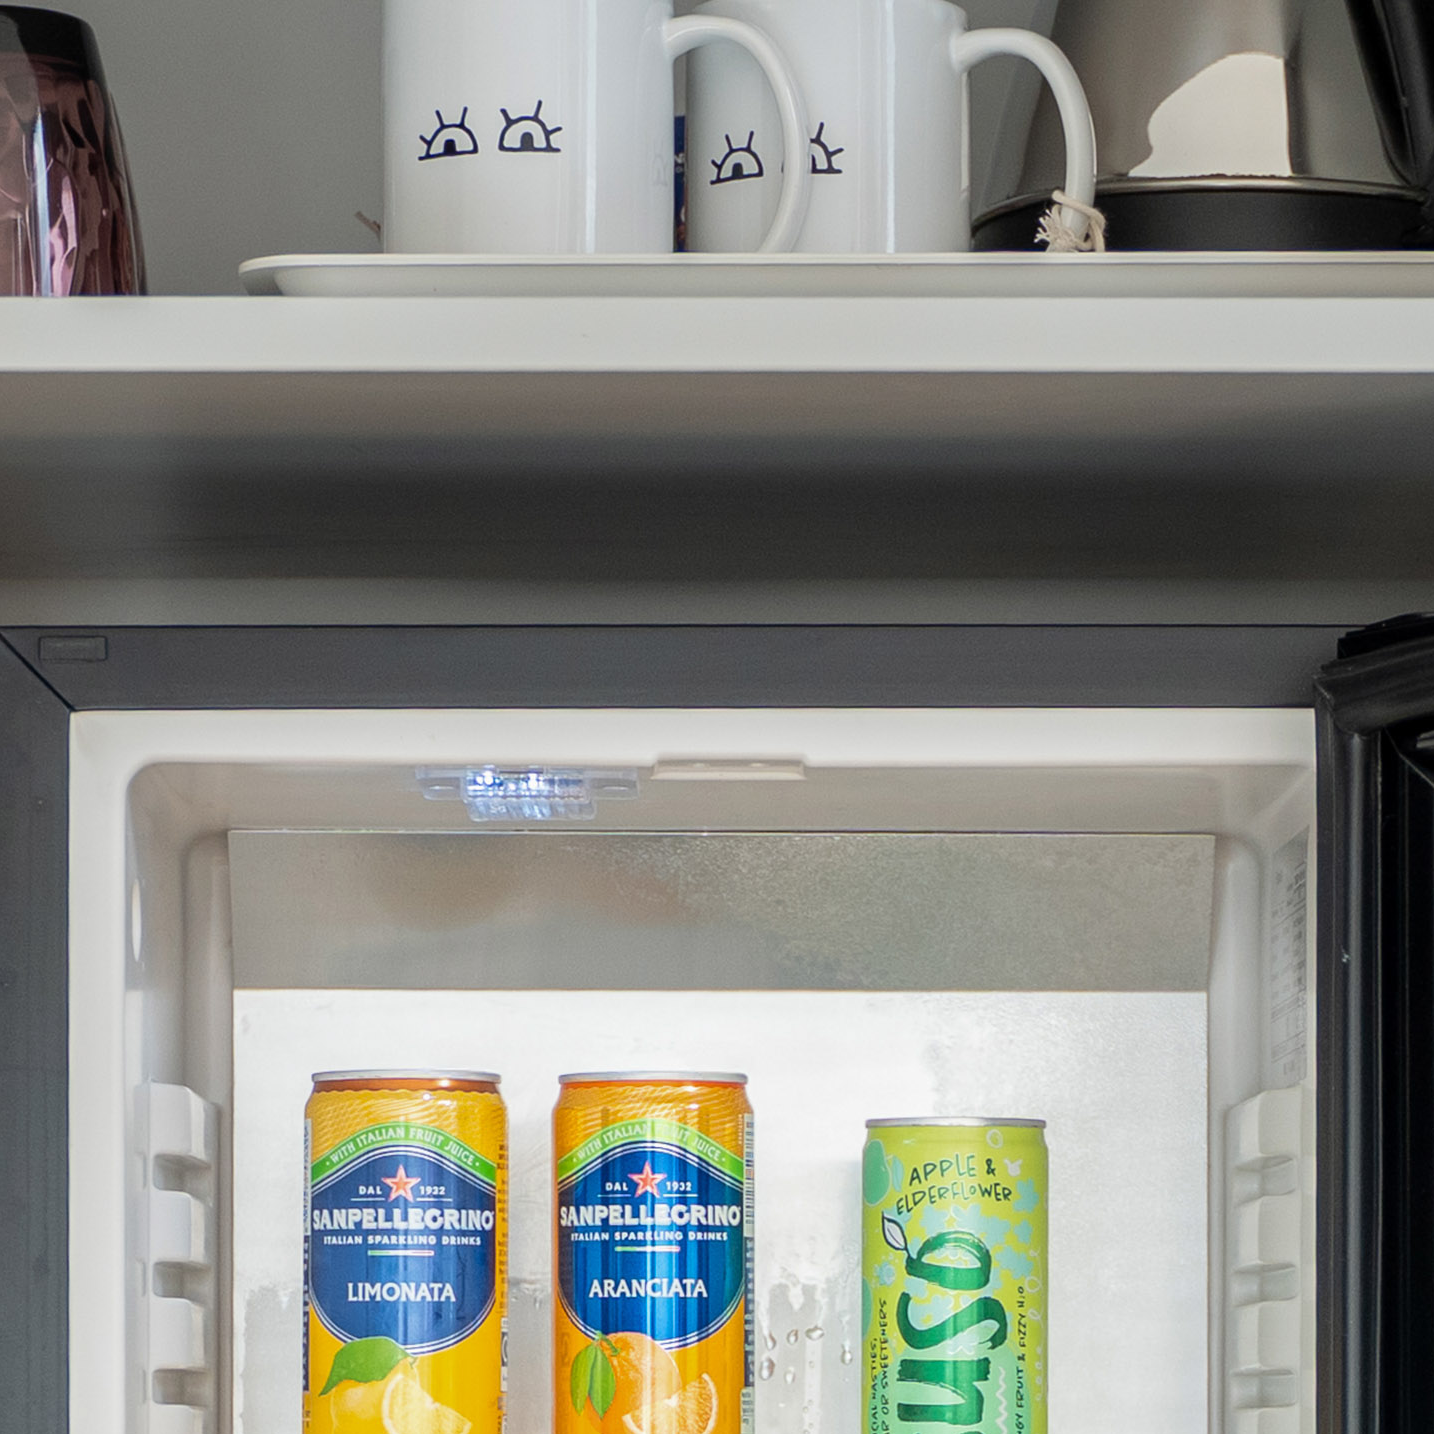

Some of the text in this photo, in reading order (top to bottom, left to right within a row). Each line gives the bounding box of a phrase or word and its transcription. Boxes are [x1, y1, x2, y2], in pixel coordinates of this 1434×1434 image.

[330, 1127, 474, 1166] WITH ITALIAN FRUIT JUICE
[577, 1138, 602, 1160] WITH
[602, 1122, 651, 1144] ITALIAN
[691, 1135, 722, 1161] JUICE
[909, 1154, 996, 1186] APPLE &
[358, 1186, 382, 1195] DAL
[605, 1182, 692, 1191] DAL 1932
[895, 1182, 1013, 1216] ELDERFLOWER
[312, 1208, 495, 1231] SANPELLEGRINO
[560, 1204, 742, 1226] SANPELLEGRINO
[323, 1235, 481, 1246] ITALIAN SPARKLING DRINKS
[571, 1231, 728, 1241] ITALIAN SPARKLING DRINKS
[347, 1282, 456, 1302] LIMONATA
[589, 1278, 708, 1298] ARANCIATA
[1017, 1312, 1027, 1346] FIZZY
[879, 1296, 889, 1389] SWEETENERS
[1015, 1366, 1026, 1408] FRUIT
[880, 1393, 889, 1414] OR
